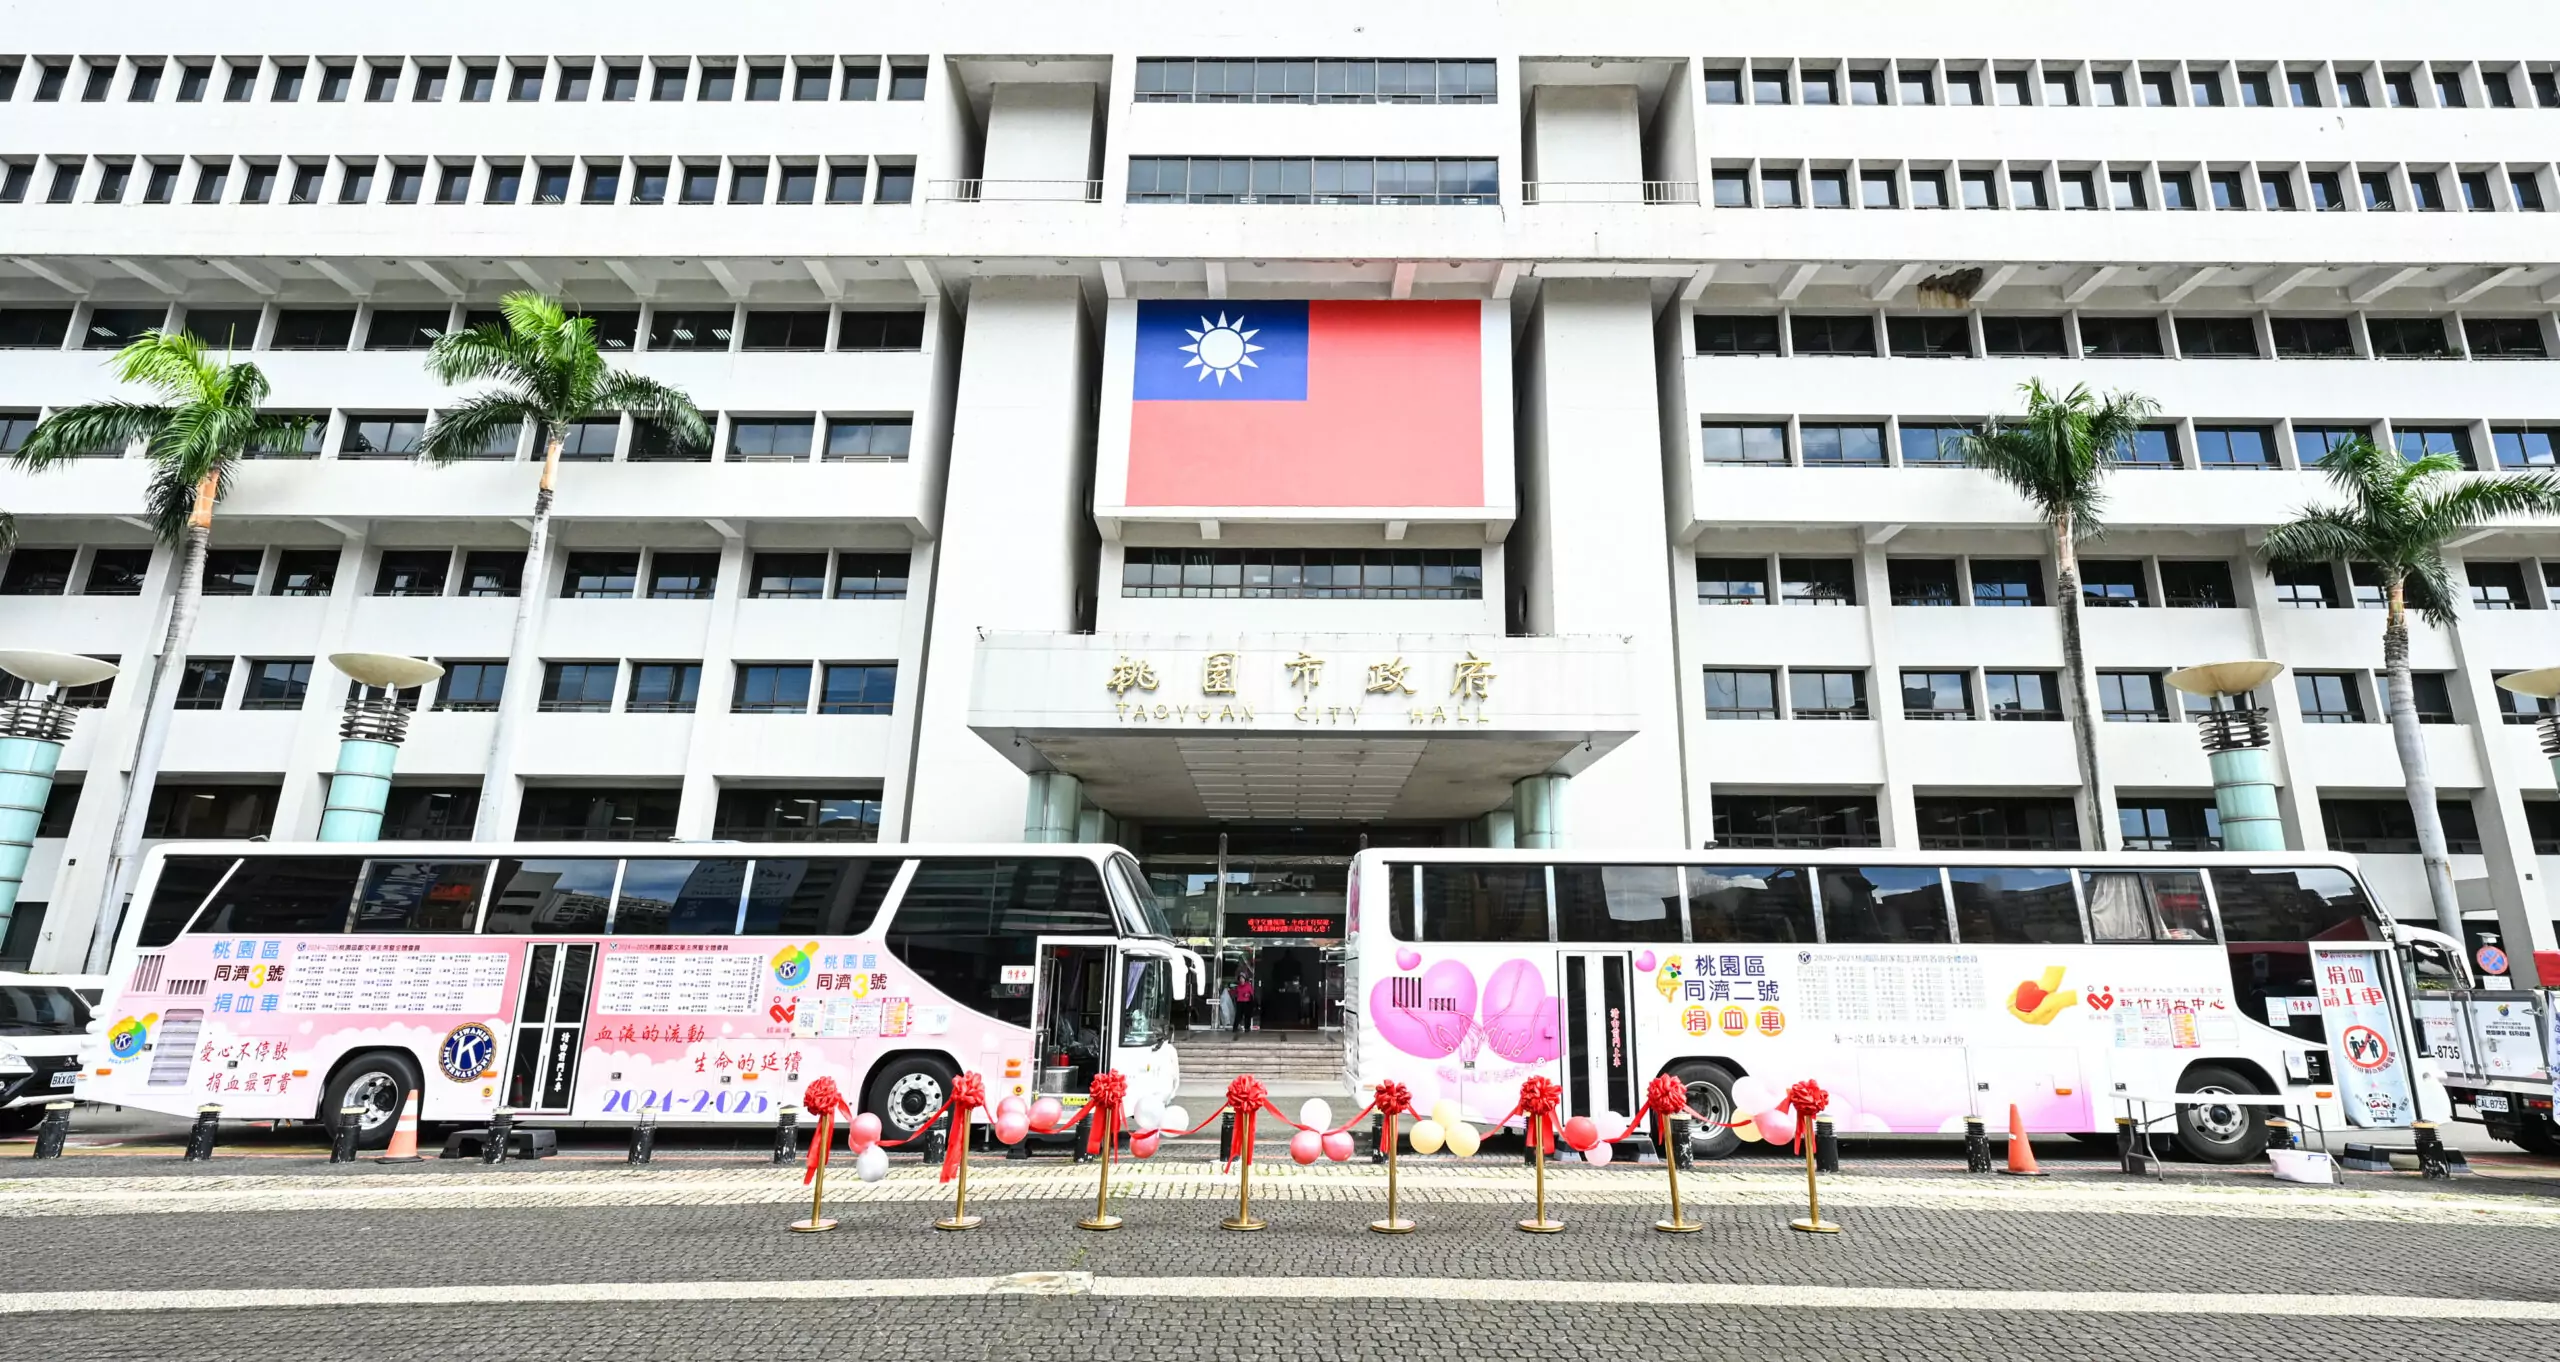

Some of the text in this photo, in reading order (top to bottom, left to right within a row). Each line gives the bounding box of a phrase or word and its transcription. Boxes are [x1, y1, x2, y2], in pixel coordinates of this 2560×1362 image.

[1107, 652, 1497, 700] 桃園市政府
[1115, 703, 1489, 723] TAOYUAN CITY HALL
[213, 940, 281, 959] 桃園區
[824, 954, 877, 970] 桃園區
[1695, 955, 1766, 977] 桃園區
[214, 964, 285, 989] 同濟3號
[817, 973, 887, 999] 同濟3號
[2327, 966, 2365, 985] 捐血
[1685, 980, 1779, 1001] 同濟二號
[2322, 987, 2385, 1008] 請上車
[213, 993, 280, 1013] 捐血車
[2120, 997, 2225, 1012] 新竹捐血中心
[1687, 1010, 1781, 1031] 捐血車
[453, 1027, 490, 1042] KIWANIS
[595, 1024, 705, 1043] 血液的流動
[201, 1041, 288, 1062] 愛心不停歇
[553, 1032, 571, 1092] 請由前門上車
[694, 1051, 803, 1073] 生命的延續
[444, 1047, 492, 1078] INTERNATIONAL
[206, 1072, 292, 1094] 捐血最可貴
